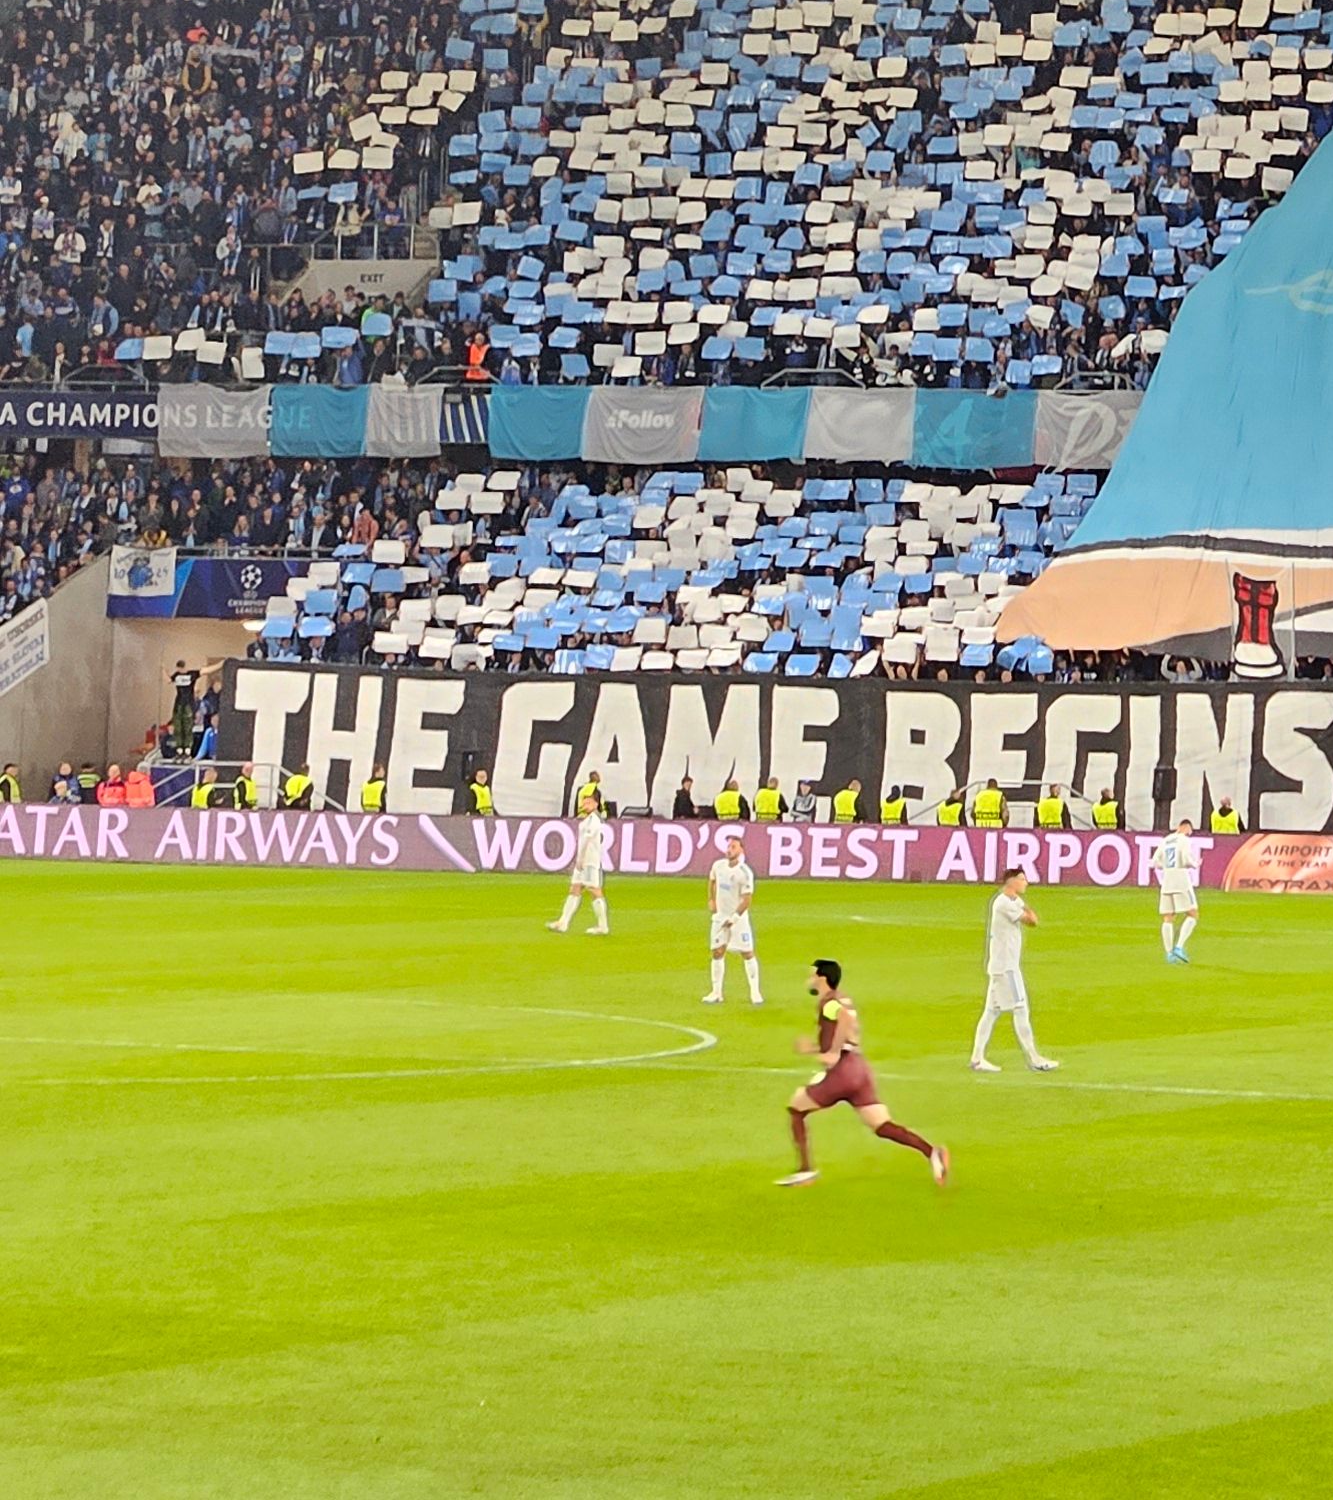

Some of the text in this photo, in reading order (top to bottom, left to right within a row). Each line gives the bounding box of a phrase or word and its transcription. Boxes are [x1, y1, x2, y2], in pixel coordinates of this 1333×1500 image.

[26, 401, 198, 429] CHAMPIONS
[205, 403, 312, 429] LEAGUE
[235, 668, 466, 816] THE
[492, 681, 840, 820] GAME
[155, 812, 400, 867] AIRWAYS
[473, 821, 745, 875] WORLD'S
[766, 826, 921, 882] BEST
[936, 830, 1214, 887] AIRPORT
[1259, 859, 1328, 868] OF THE YEAR
[1261, 844, 1333, 857] AIRPORT
